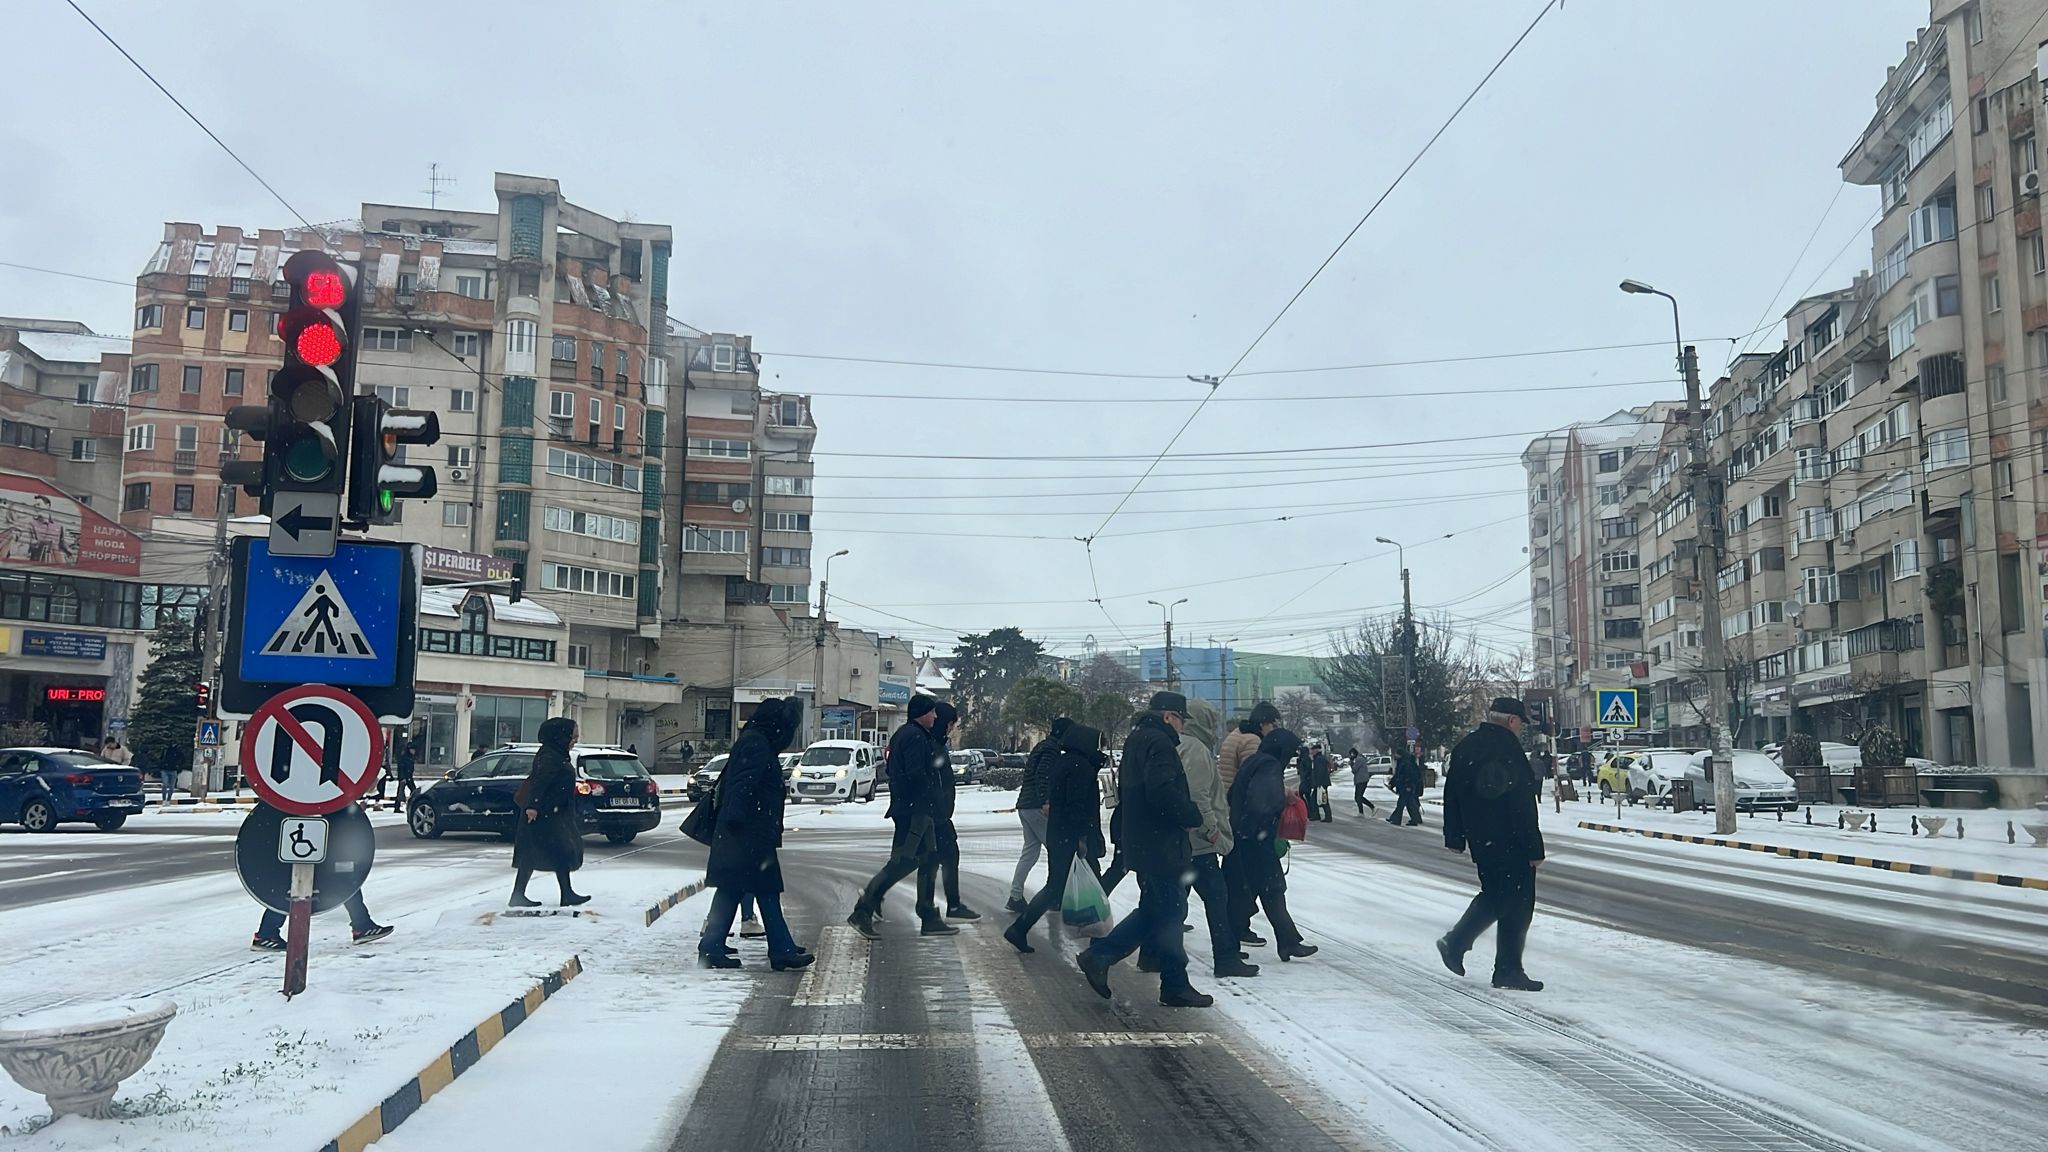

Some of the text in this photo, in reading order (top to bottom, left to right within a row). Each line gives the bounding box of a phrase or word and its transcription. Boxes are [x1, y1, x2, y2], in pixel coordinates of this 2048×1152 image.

[93, 525, 127, 537] HAPPY
[95, 539, 125, 549] MODA
[81, 551, 136, 564] SHOPPING
[438, 553, 481, 572] PERDELE
[487, 567, 511, 579] DLD
[48, 689, 69, 699] URI
[78, 690, 105, 700] PRO
